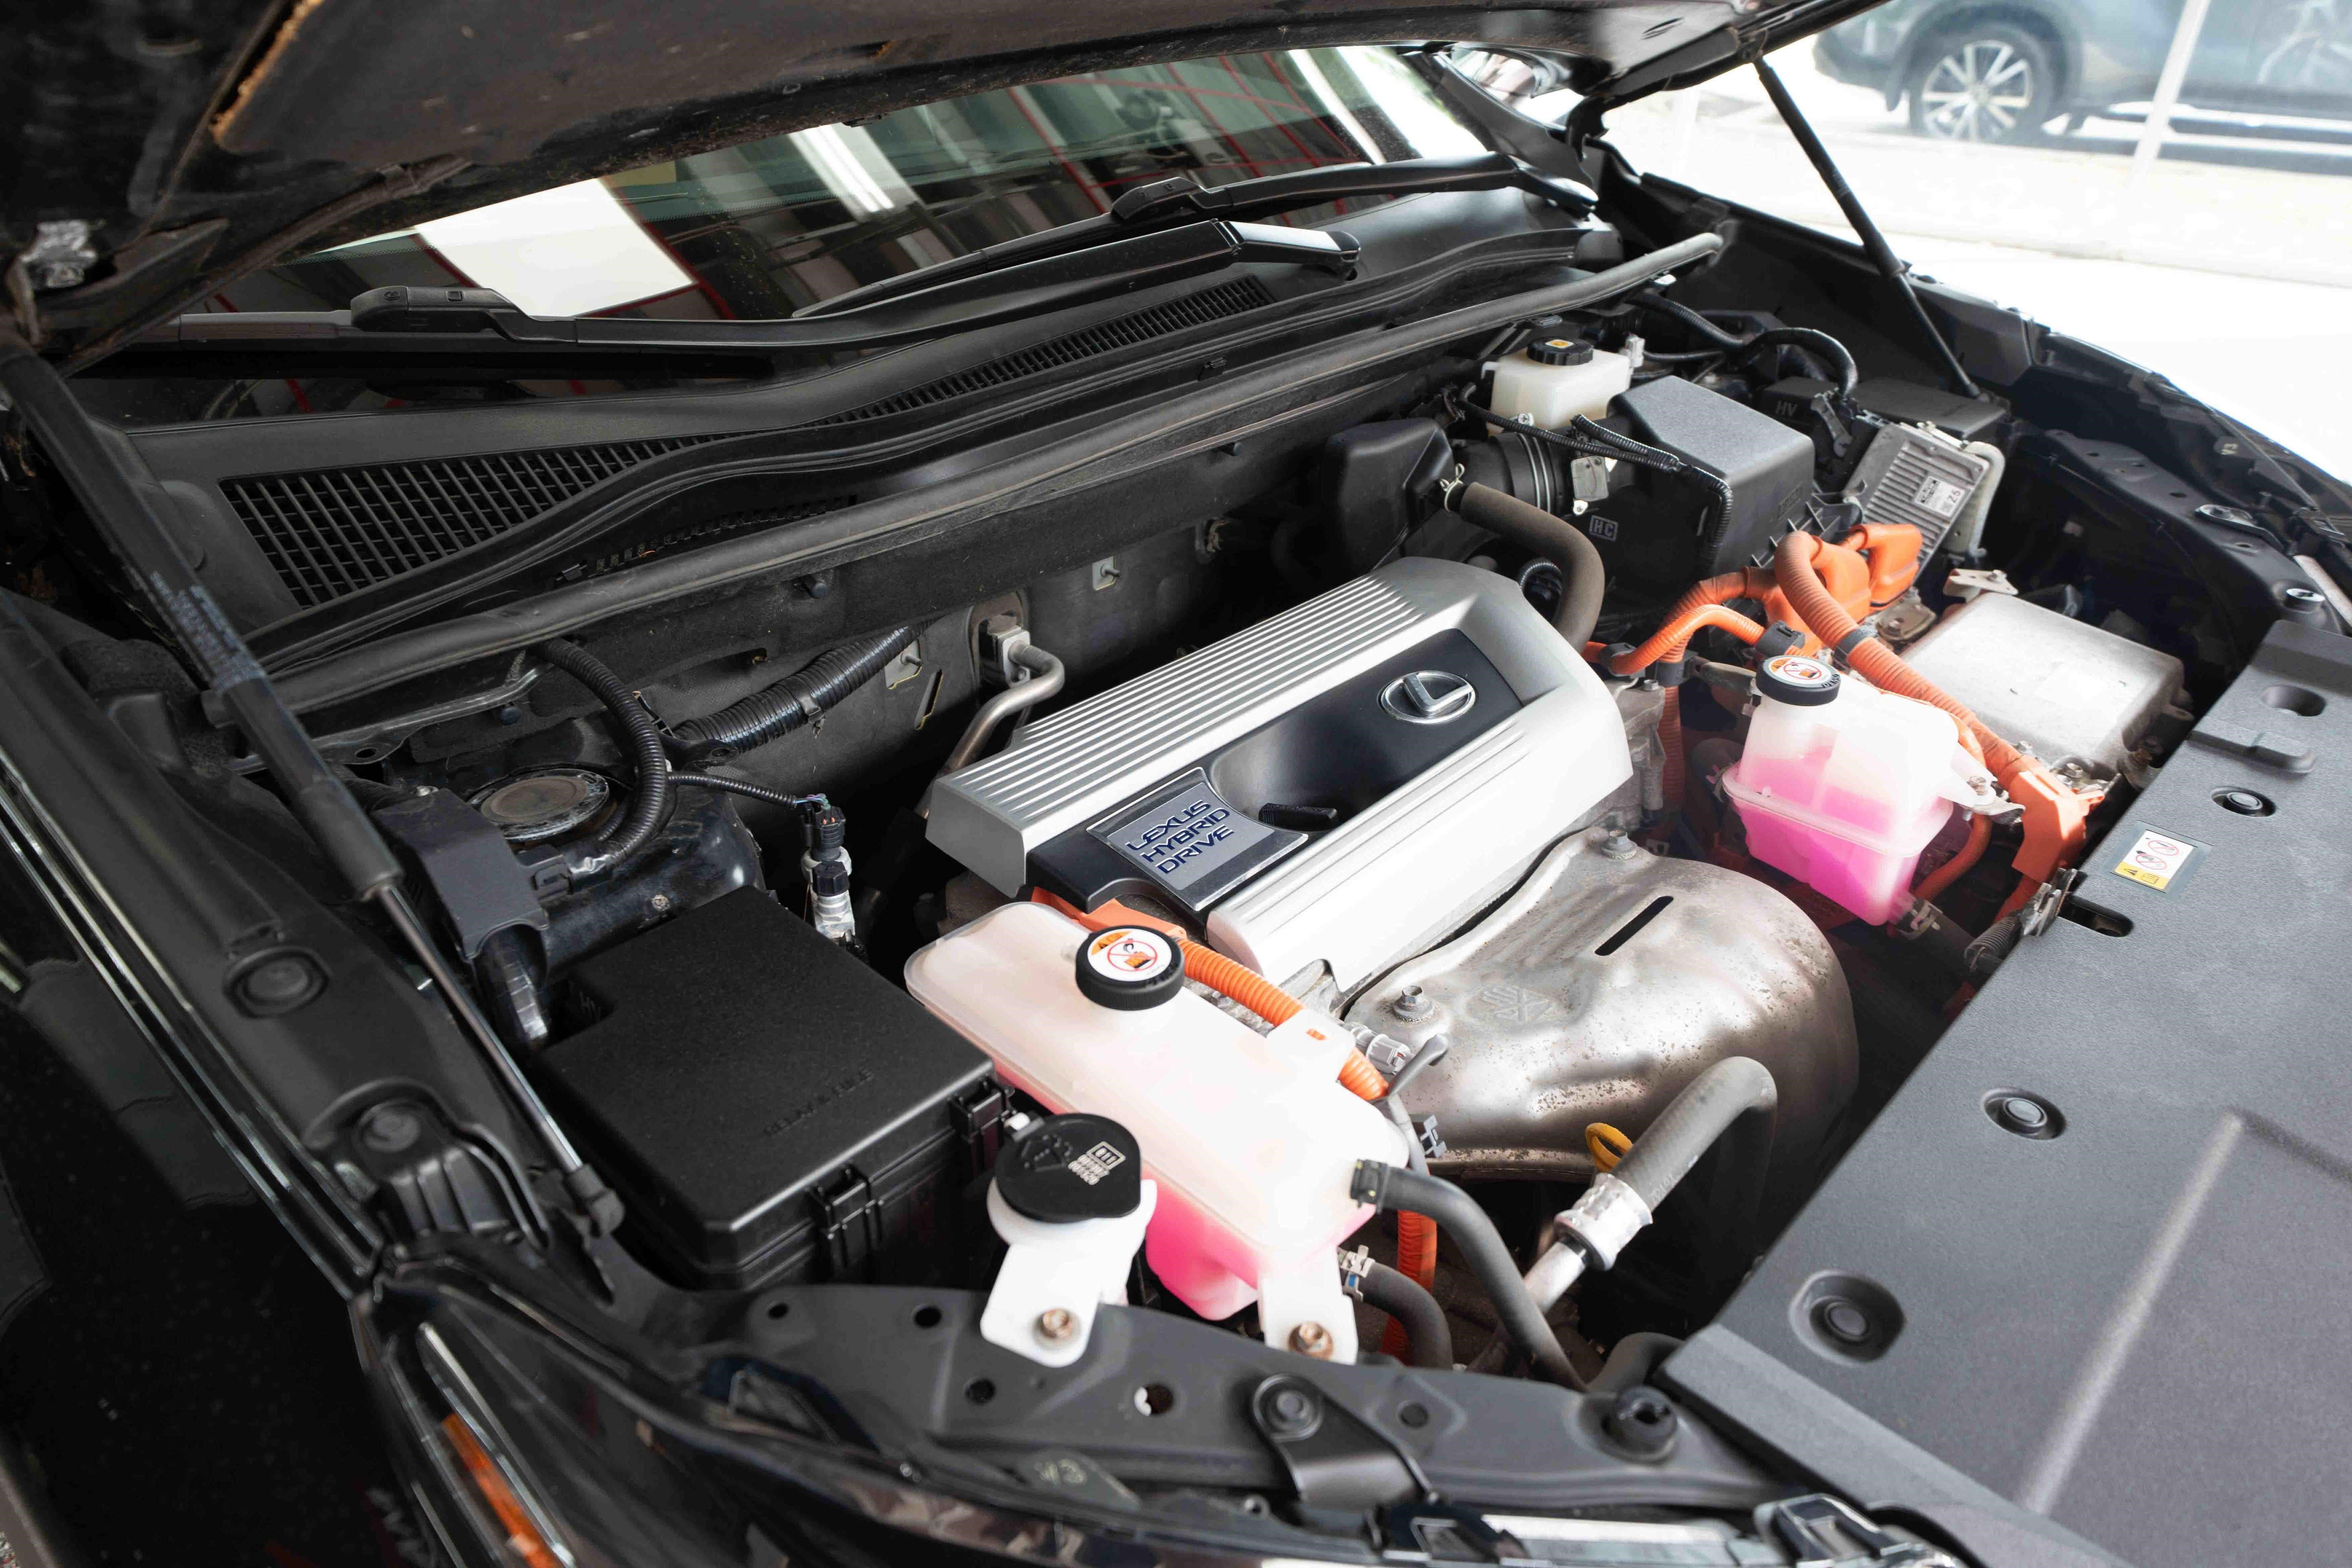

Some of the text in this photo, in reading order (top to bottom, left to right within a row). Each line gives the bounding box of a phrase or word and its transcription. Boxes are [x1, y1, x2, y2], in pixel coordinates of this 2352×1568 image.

[1593, 519, 1613, 537] HC
[1125, 799, 1211, 851] LEXUS
[1140, 807, 1230, 863] HYBRID
[1155, 824, 1235, 874] DRIVE
